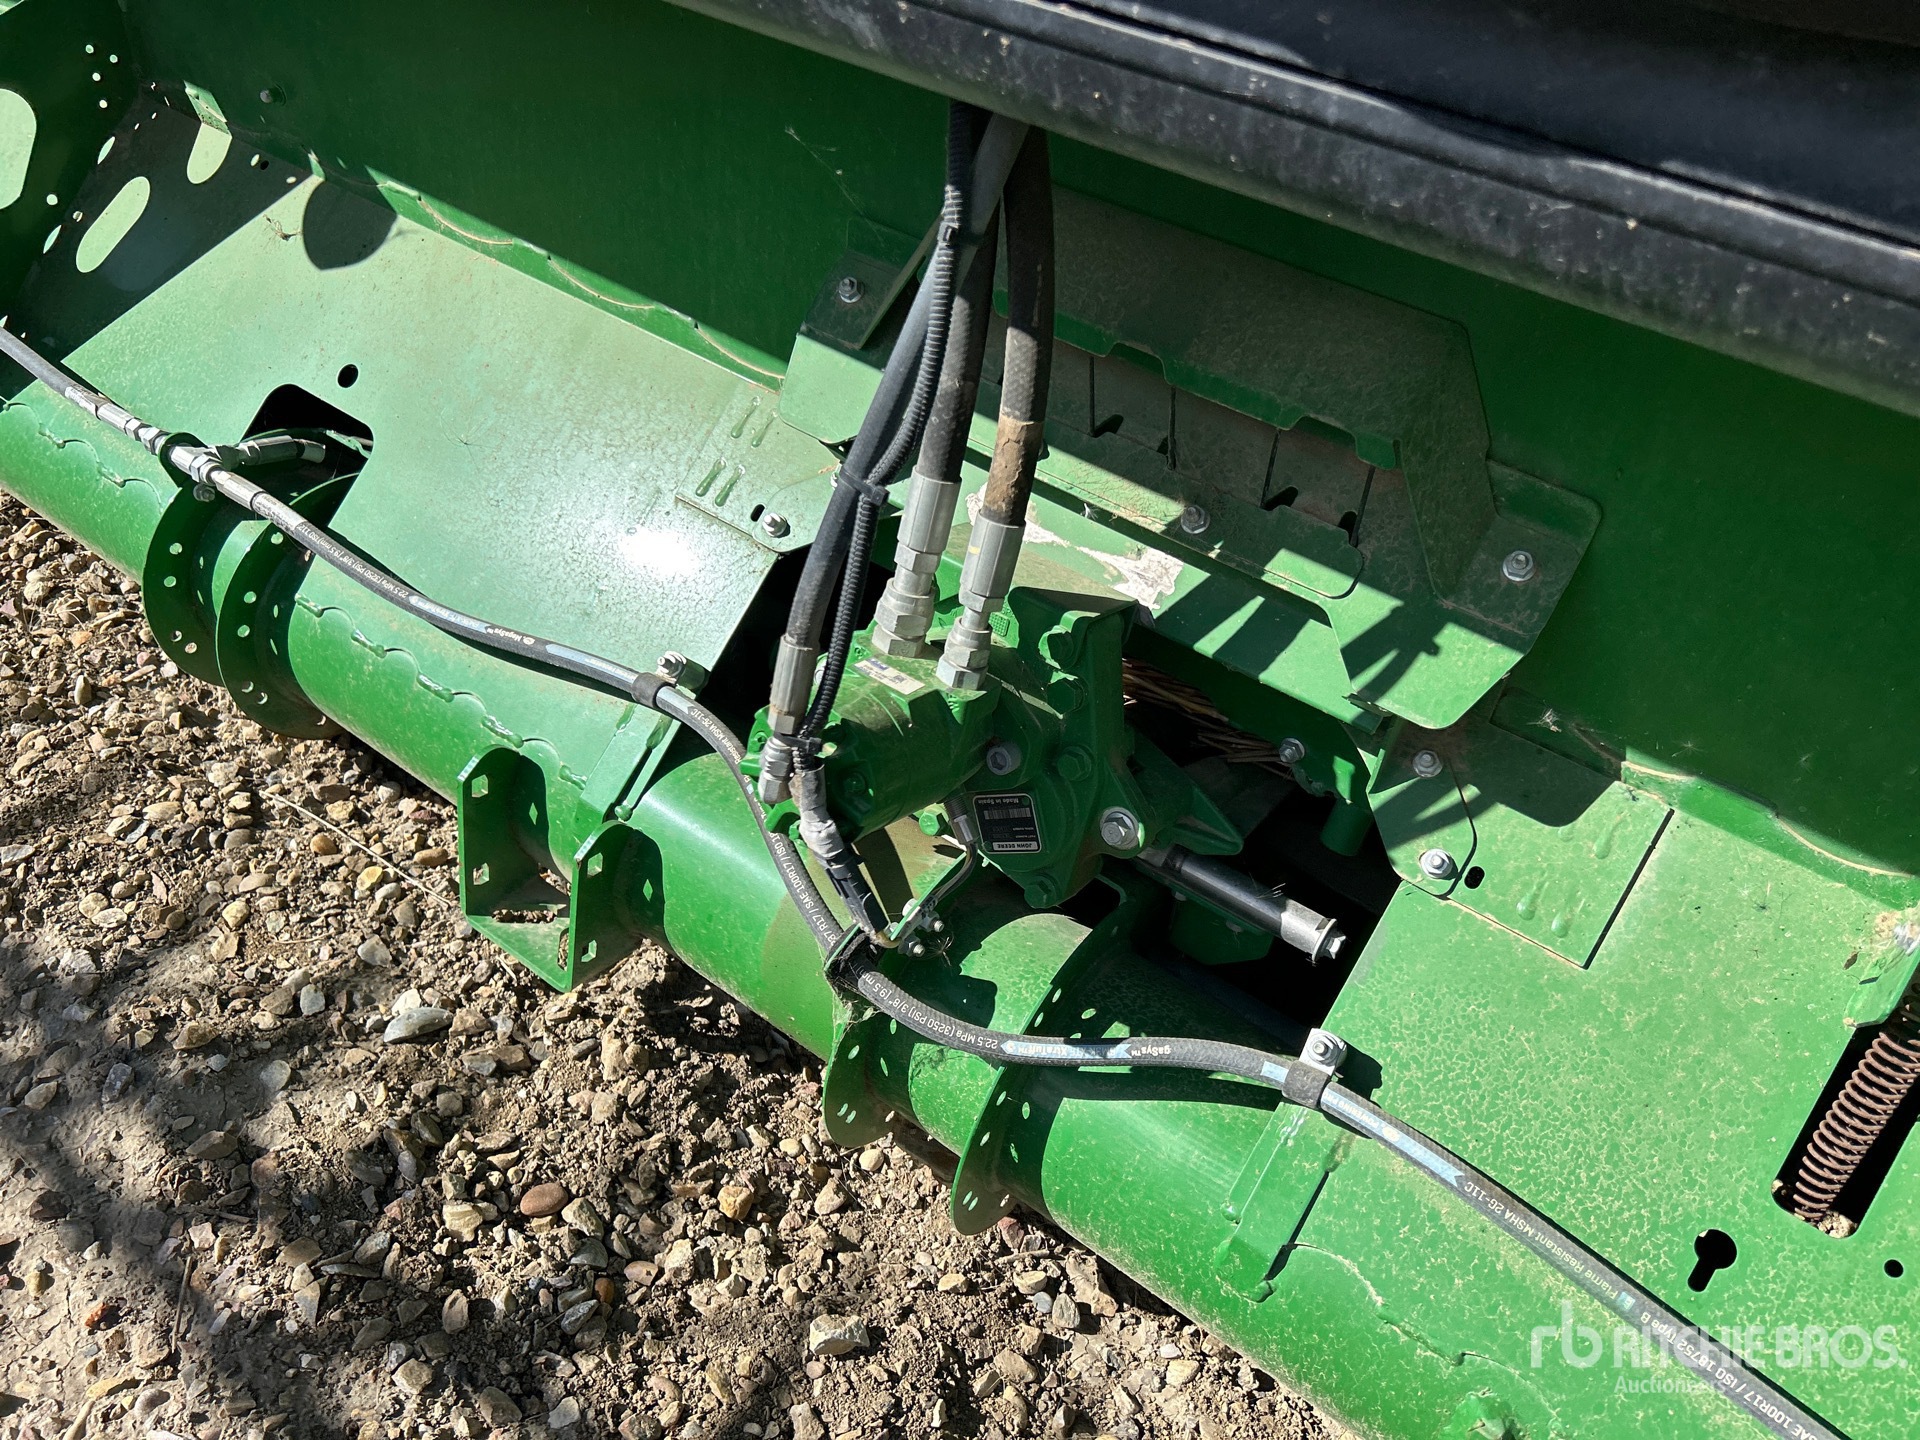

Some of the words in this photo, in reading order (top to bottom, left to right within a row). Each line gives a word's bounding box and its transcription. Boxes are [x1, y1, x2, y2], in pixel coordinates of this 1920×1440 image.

[393, 586, 408, 599] 22.5
[707, 723, 724, 740] MSHA
[774, 840, 786, 857] ISO
[782, 859, 805, 892] 100R17
[799, 891, 814, 909] SAE
[812, 912, 828, 930] R17
[955, 1029, 975, 1043] MPa
[976, 1036, 998, 1049] 22.5
[1462, 1180, 1505, 1214] 2G-11C
[1501, 1207, 1535, 1237] MSHA
[1532, 1230, 1585, 1274] Resistant
[1582, 1267, 1619, 1299] Flame
[1638, 1310, 1651, 1324] B
[1648, 1317, 1679, 1344] Type
[1675, 1337, 1716, 1372] 18752
[1713, 1365, 1739, 1388] ISO
[1742, 1387, 1793, 1428] 100R17
